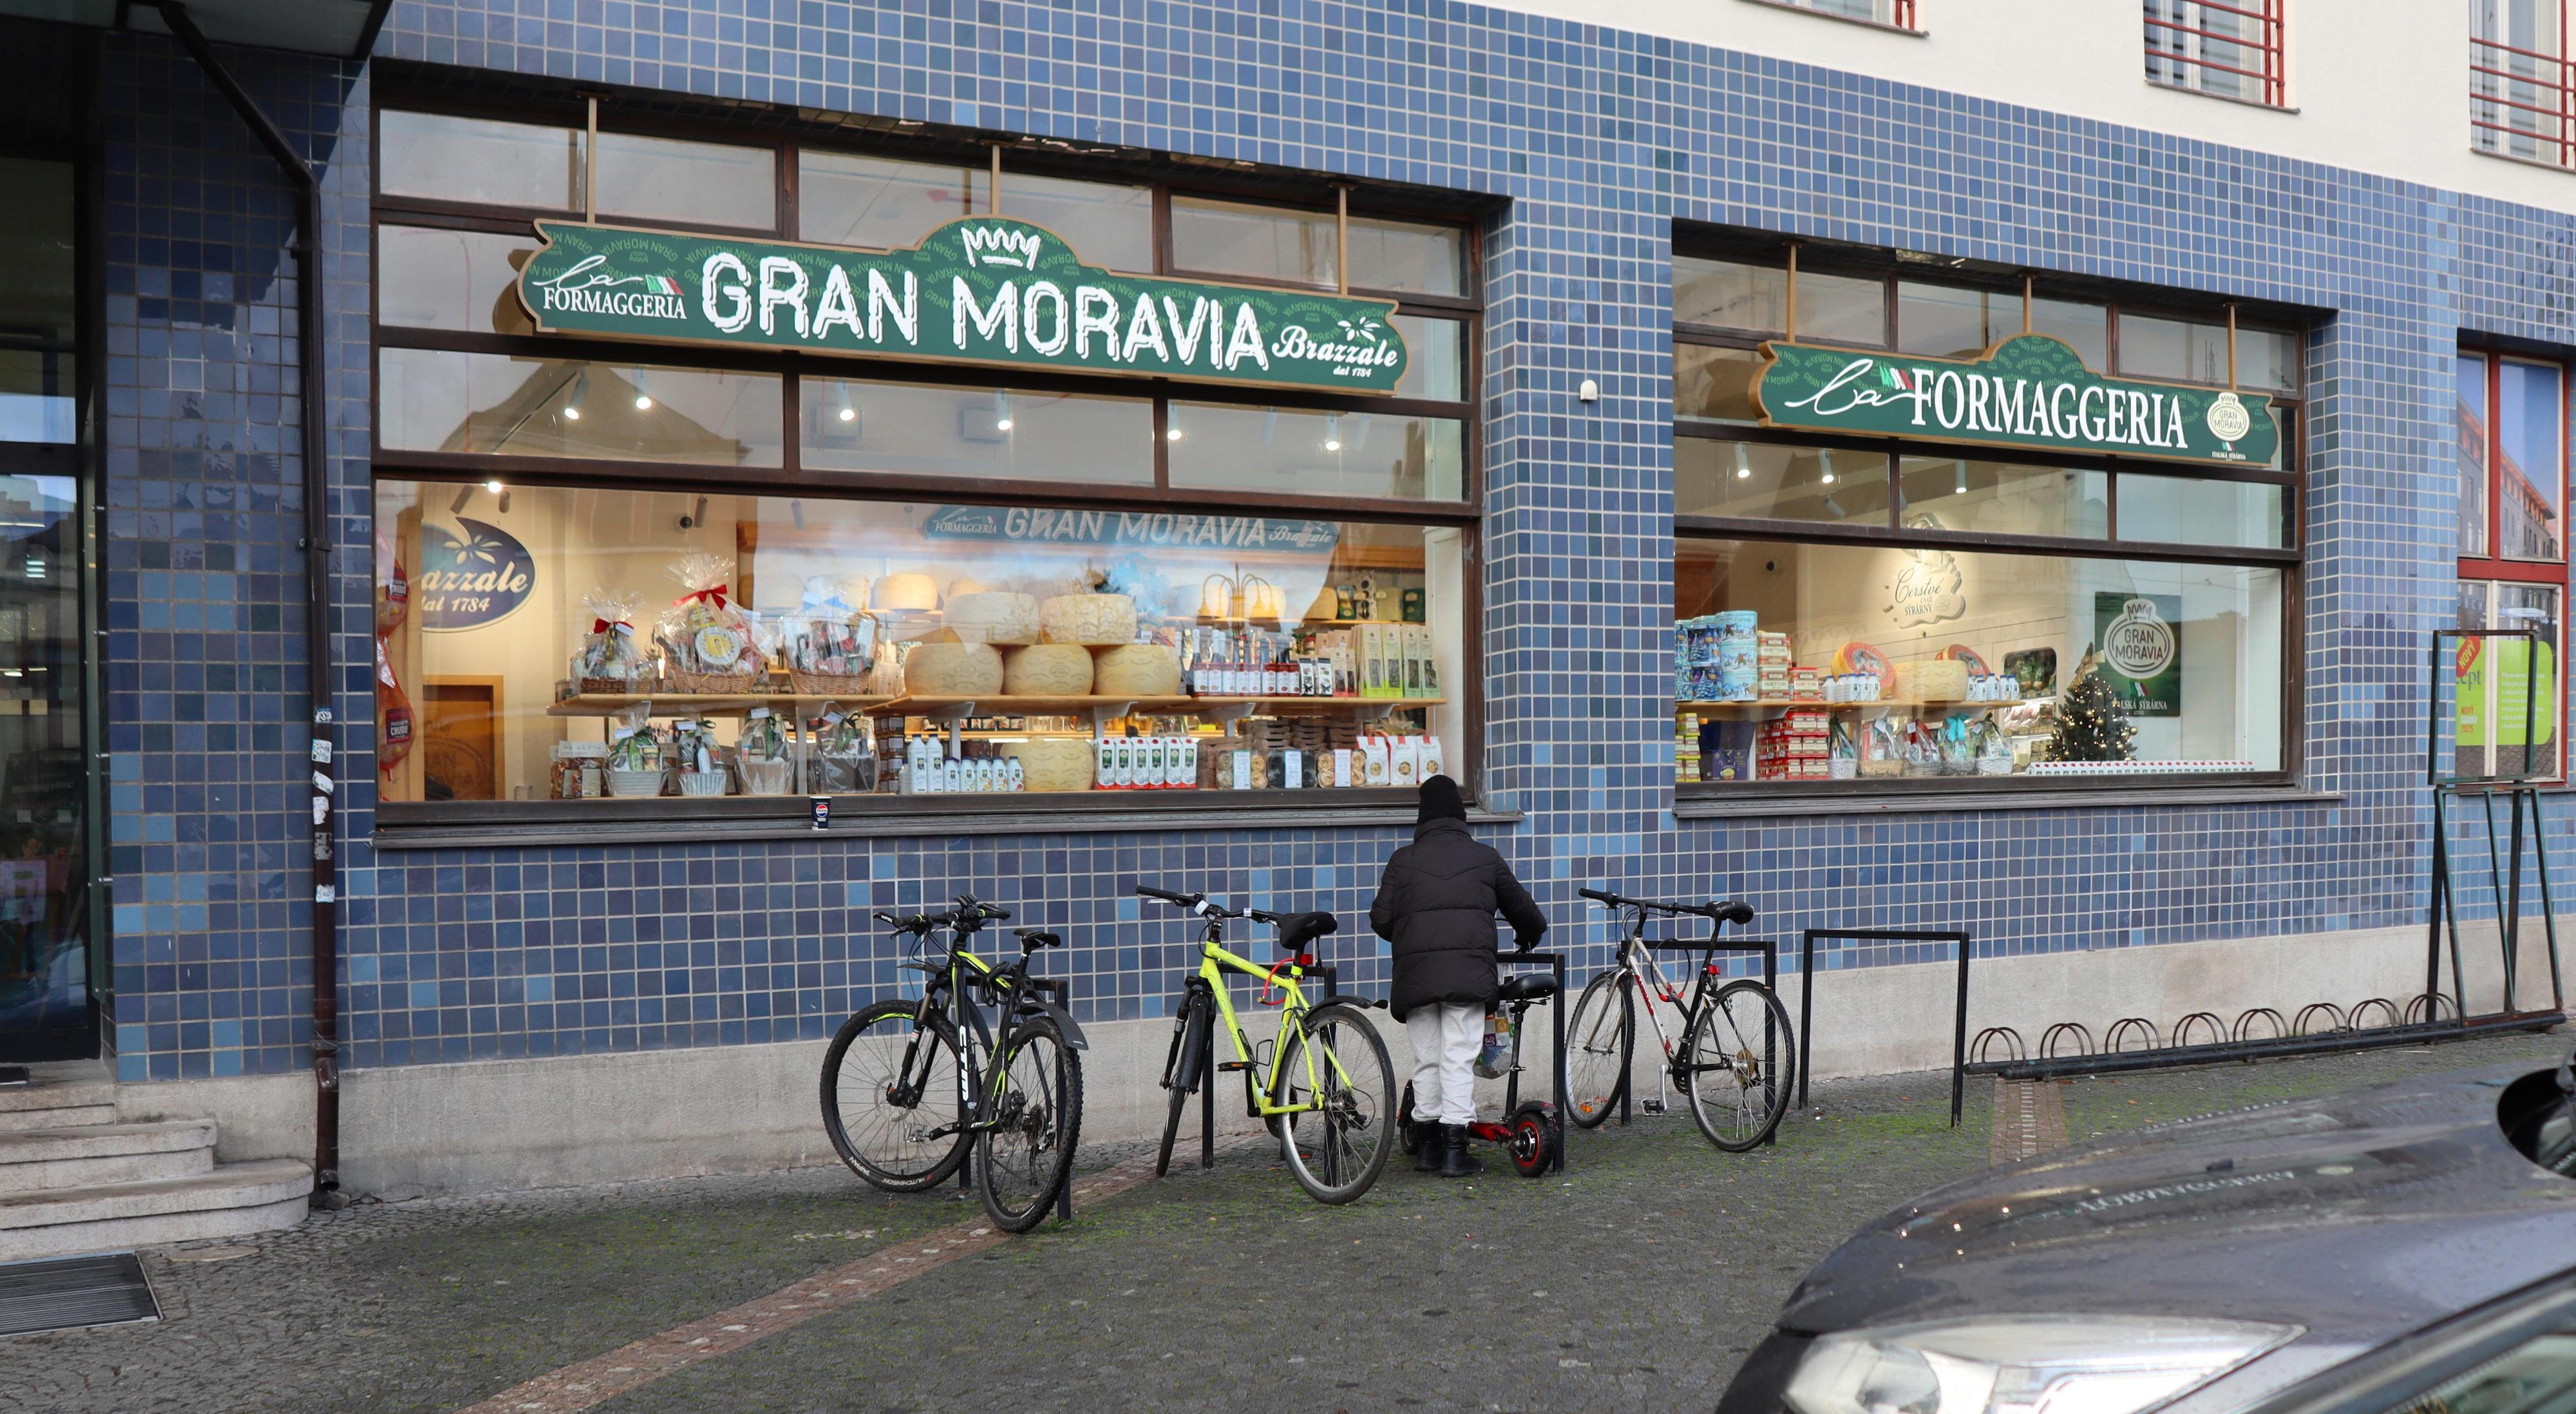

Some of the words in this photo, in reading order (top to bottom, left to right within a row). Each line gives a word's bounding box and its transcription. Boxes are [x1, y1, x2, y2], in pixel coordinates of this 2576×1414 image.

[544, 287, 687, 320] FORMAGGERIA
[702, 251, 917, 346] GRAN
[952, 275, 1269, 372] MORAVIA
[1271, 325, 1398, 367] Brazzale
[1333, 366, 1350, 376] dal
[1352, 367, 1372, 377] 1784
[1911, 368, 2188, 449] FORMAGGERIA
[2219, 410, 2237, 419] GRAN
[2214, 419, 2242, 429] MORAVIA
[936, 521, 997, 534] FORMAGGERIA
[1005, 508, 1105, 541] GRAN
[1115, 512, 1265, 547] MORAVIA
[1269, 525, 1332, 543] Brazale
[421, 560, 528, 593] azzale
[452, 597, 491, 612] 1784
[2125, 628, 2154, 644] GRAN
[2115, 644, 2164, 661] MORAVIA
[2117, 699, 2137, 709] ALSKÁ
[2139, 699, 2168, 709] SÝRÁRNA
[390, 725, 408, 736] CRUDO
[959, 1025, 969, 1102] CTM
[849, 1156, 870, 1176] TAIPAN
[882, 1178, 925, 1186] HUTCHINSON
